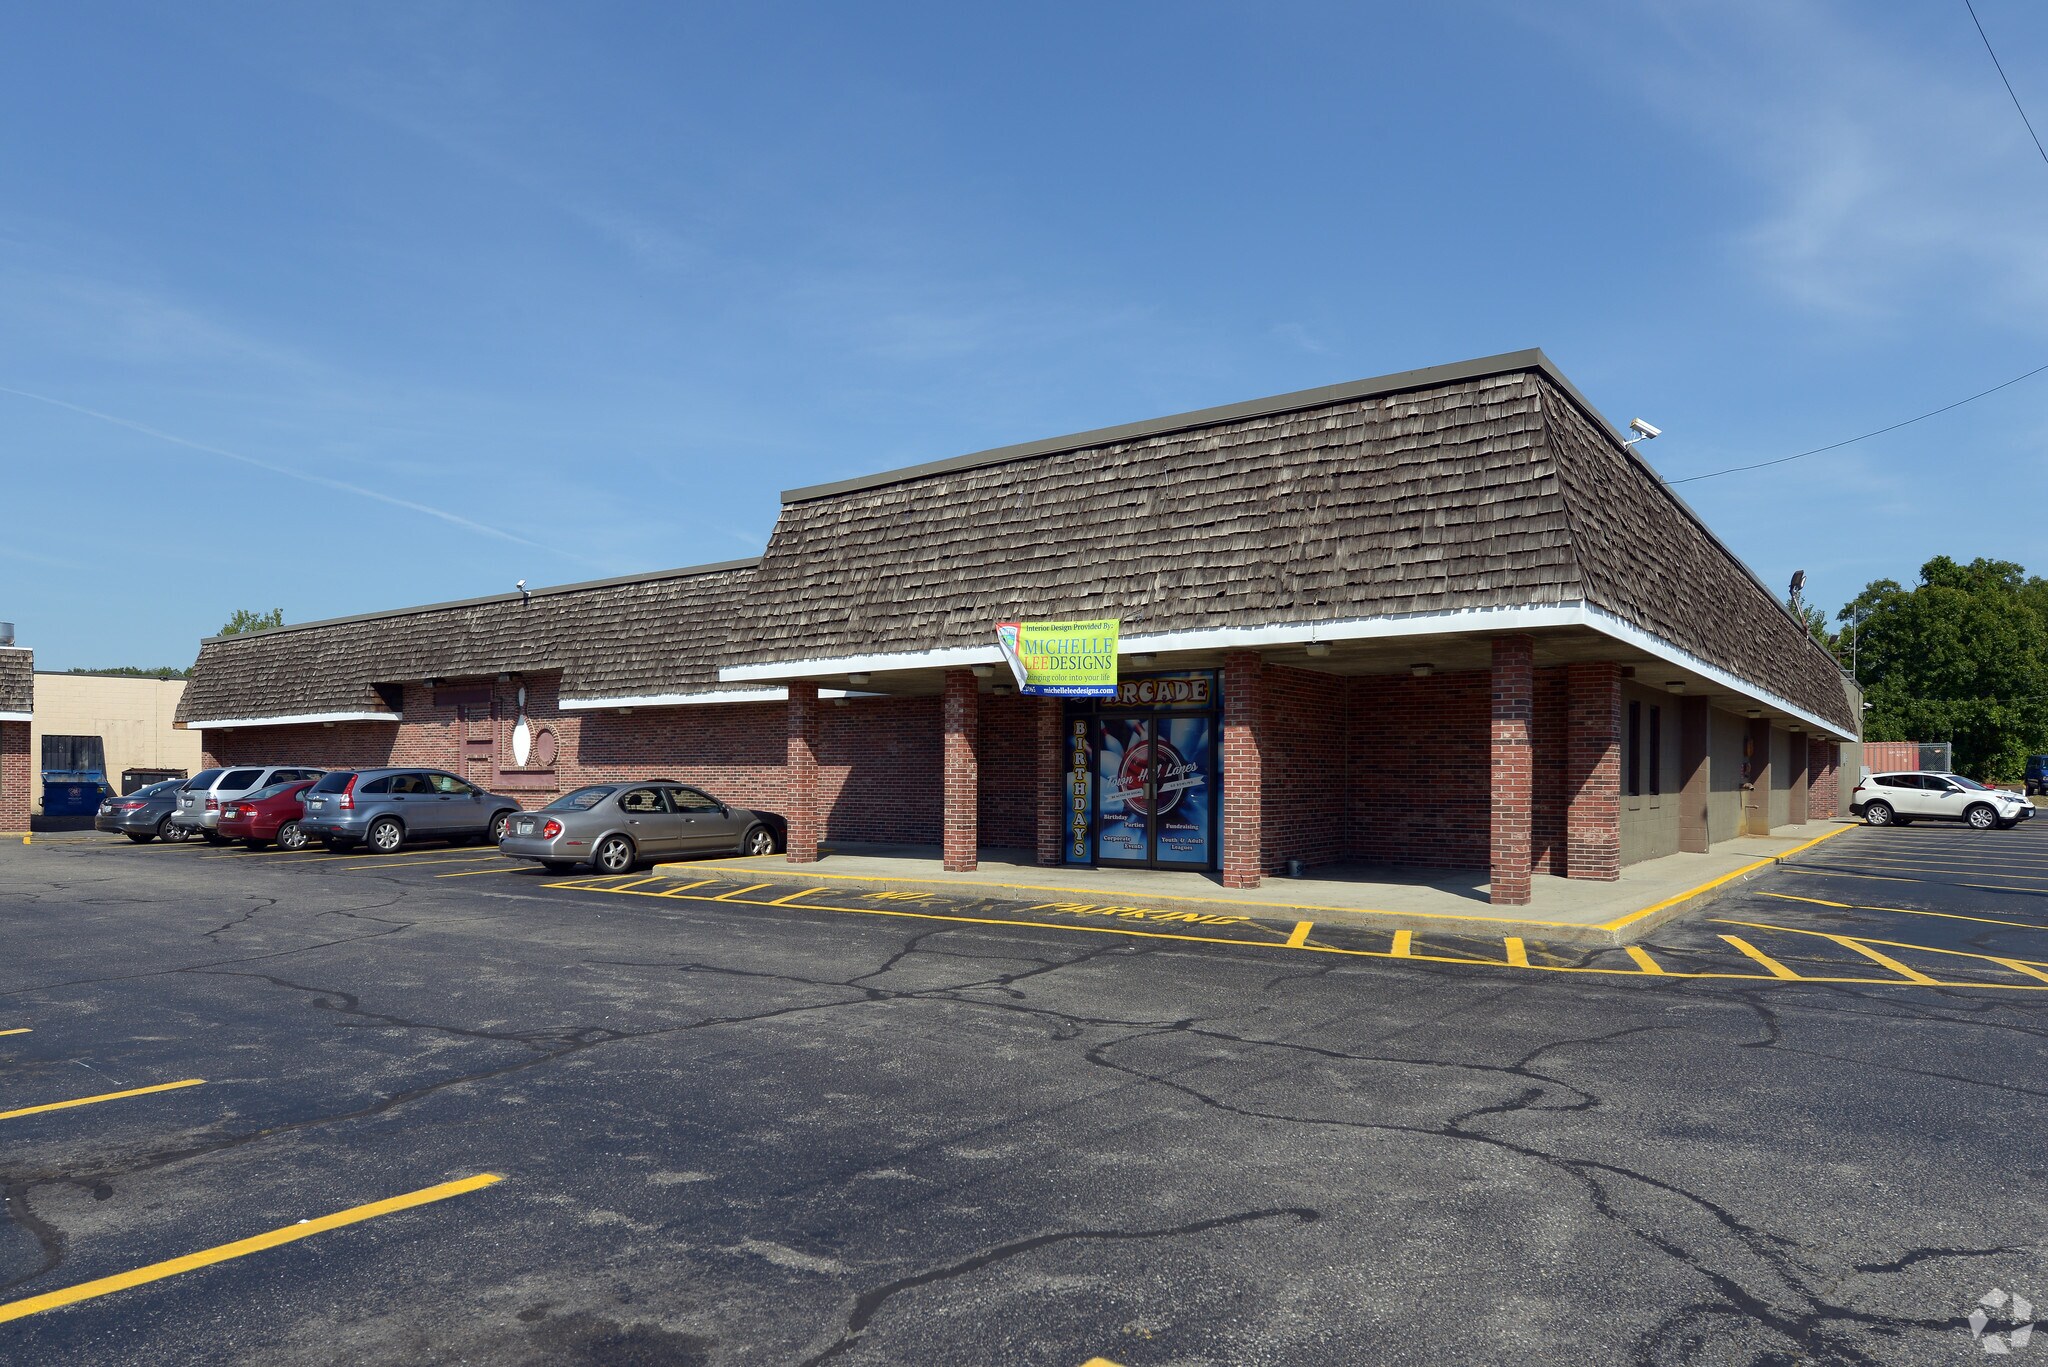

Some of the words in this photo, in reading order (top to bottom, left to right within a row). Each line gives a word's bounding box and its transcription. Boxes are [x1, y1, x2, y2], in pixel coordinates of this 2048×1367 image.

[1051, 624, 1072, 632] Design
[1024, 638, 1112, 654] MICHELLE
[1024, 655, 1112, 670] LEEDESIGNS
[1044, 686, 1114, 696] michelleleedesigns.com
[1106, 774, 1134, 788] Town
[1166, 761, 1198, 778] Lanes
[1074, 720, 1087, 857] BIRTHDAYS
[1026, 902, 1251, 924] PARKING
